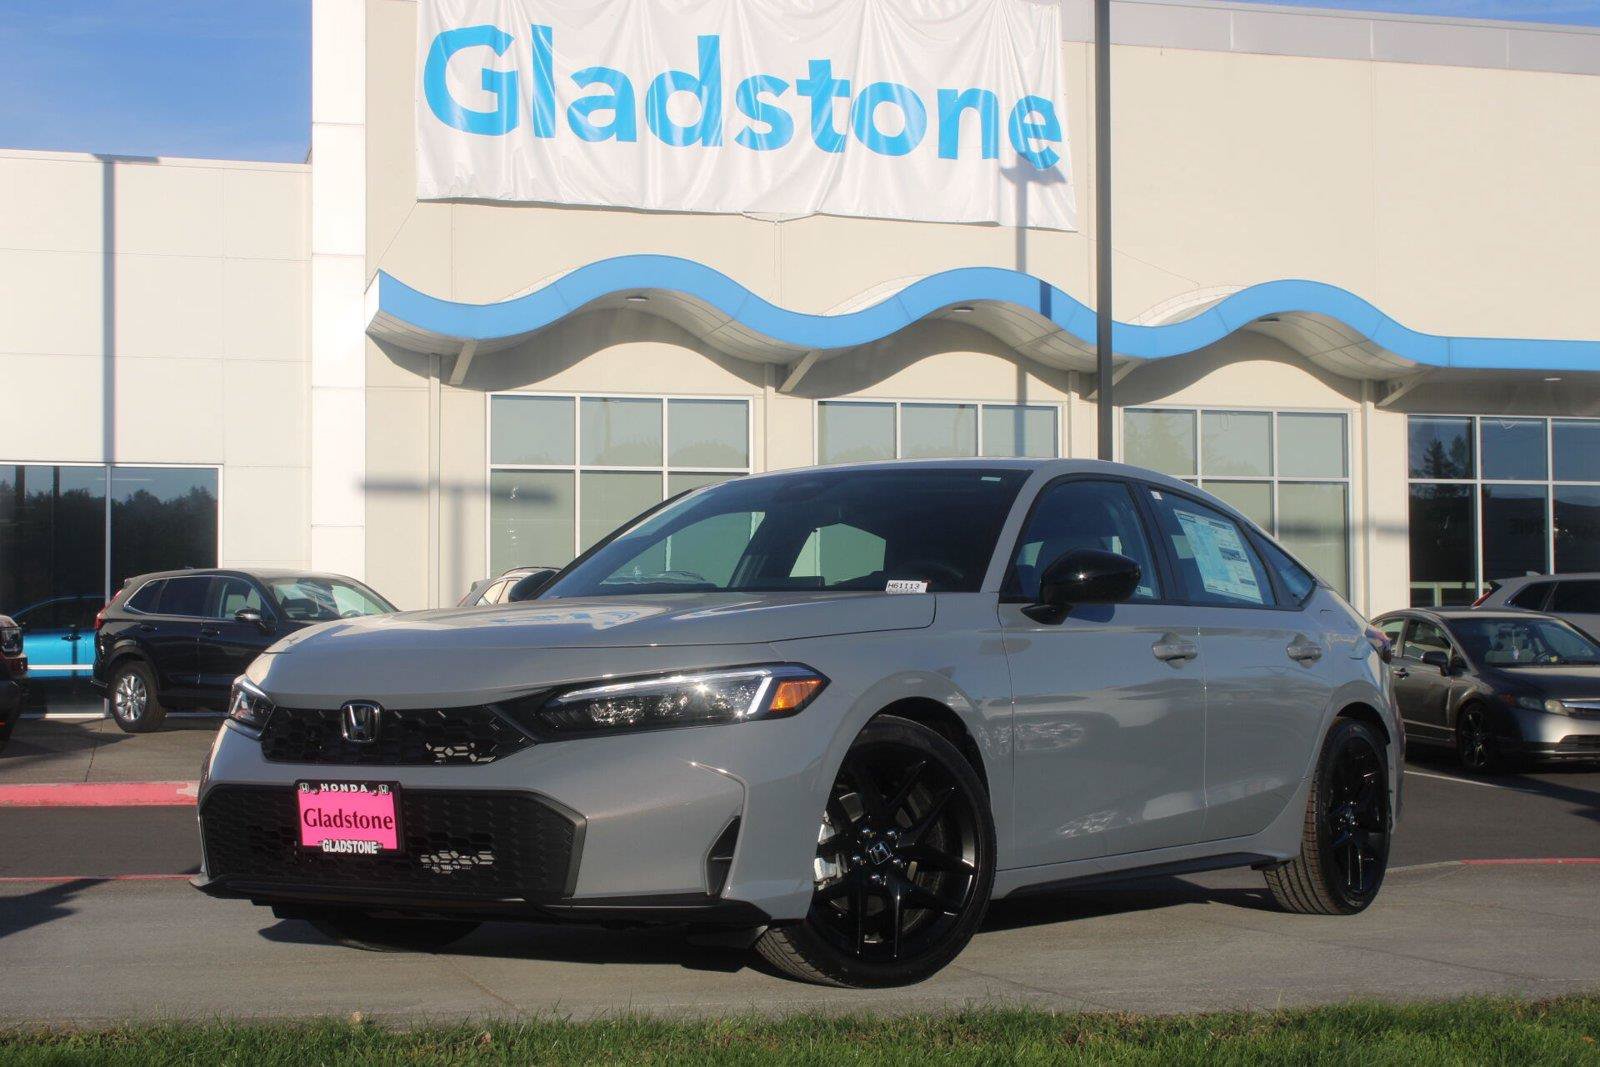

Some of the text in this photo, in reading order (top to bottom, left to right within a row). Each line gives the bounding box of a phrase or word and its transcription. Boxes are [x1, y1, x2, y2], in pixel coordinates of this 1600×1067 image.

[422, 24, 1063, 171] Gladstone
[320, 783, 368, 793] HONDA
[303, 808, 393, 830] Gladstone
[322, 839, 378, 854] GLADSTONE
